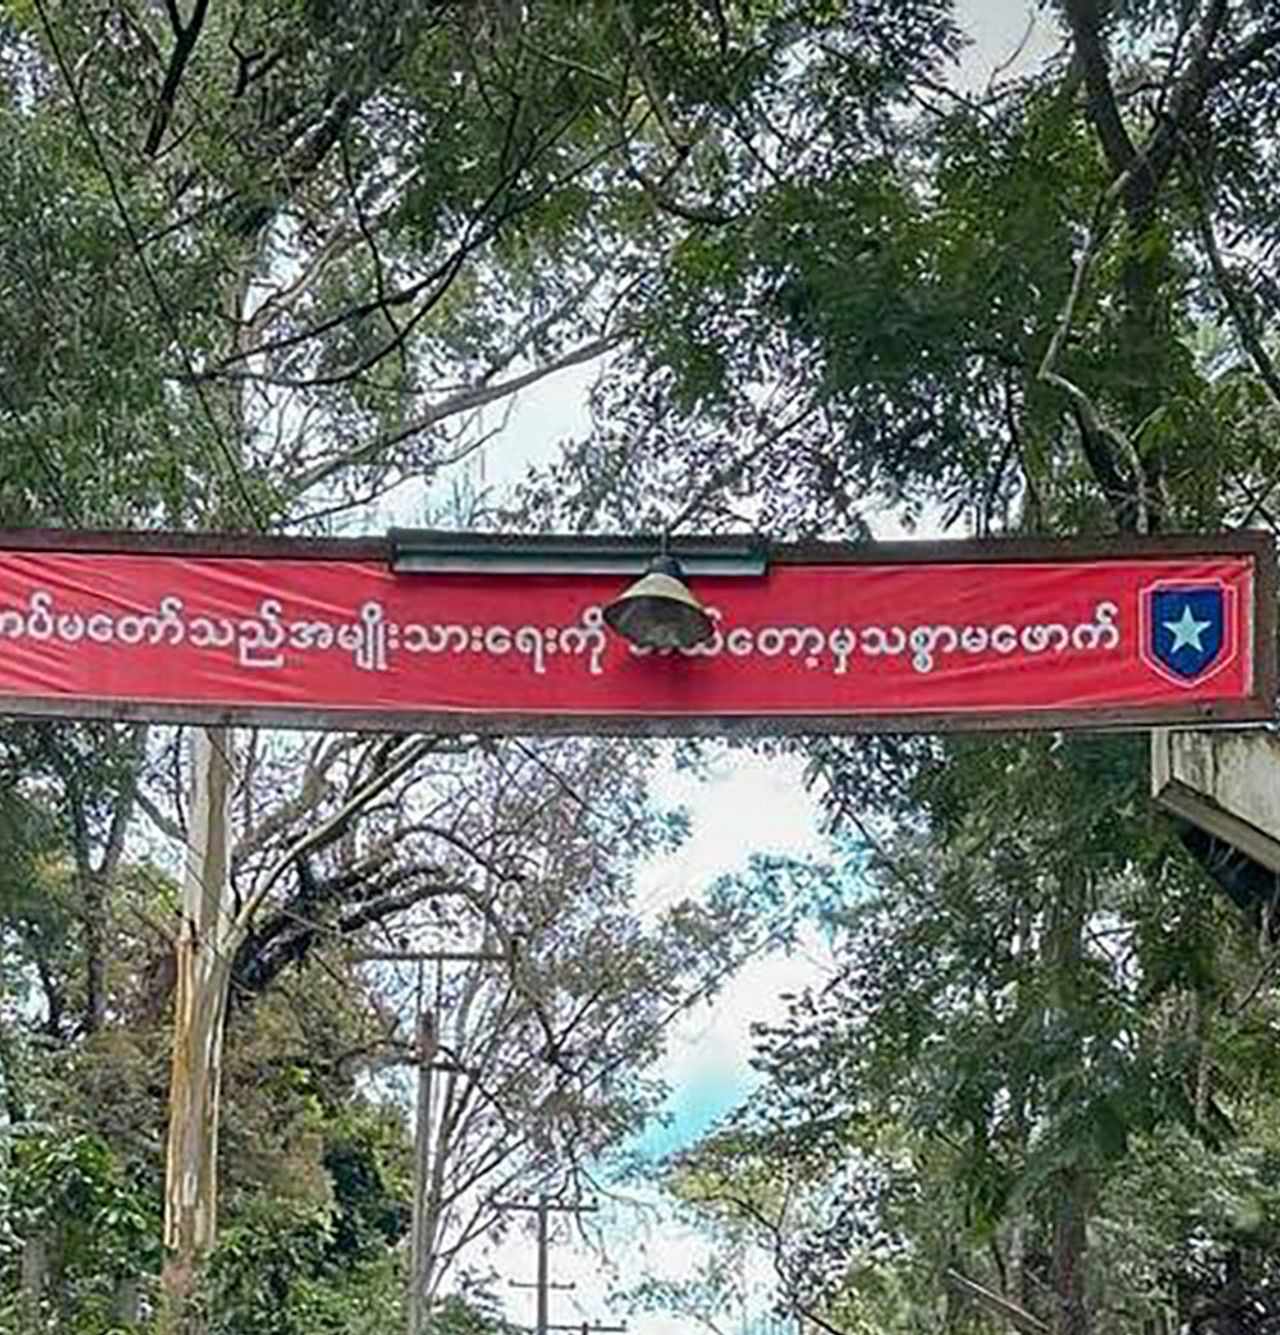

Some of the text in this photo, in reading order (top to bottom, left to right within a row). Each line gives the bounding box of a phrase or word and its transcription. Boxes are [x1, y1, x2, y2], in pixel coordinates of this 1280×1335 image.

[629, 602, 1120, 674] ်တော့မှသစ္စာမဖောက်
